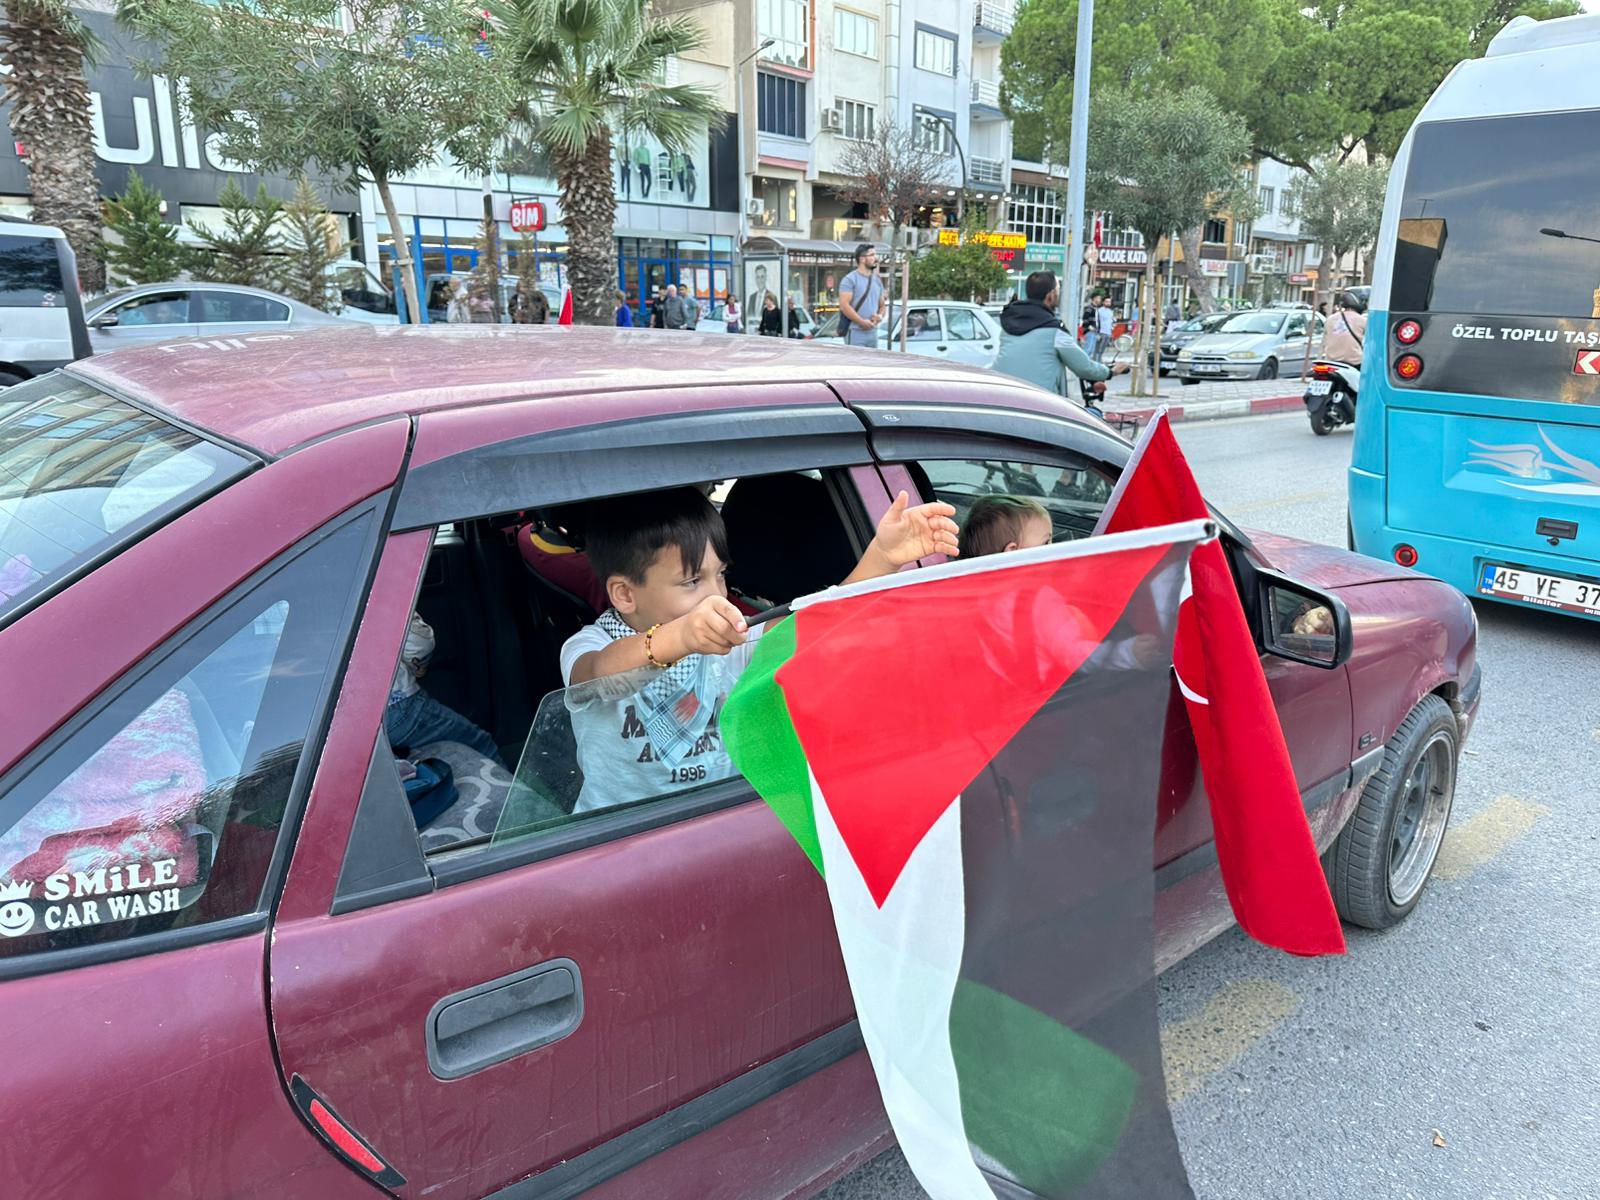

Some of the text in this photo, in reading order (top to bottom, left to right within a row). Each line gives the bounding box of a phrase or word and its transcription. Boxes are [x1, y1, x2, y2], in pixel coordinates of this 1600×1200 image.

[1099, 248, 1127, 263] CADDE
[1452, 323, 1600, 347] ÖZEL TOPLU TAŞ
[1496, 570, 1600, 606] 45 VE 37
[44, 887, 181, 931] CAR WASH
